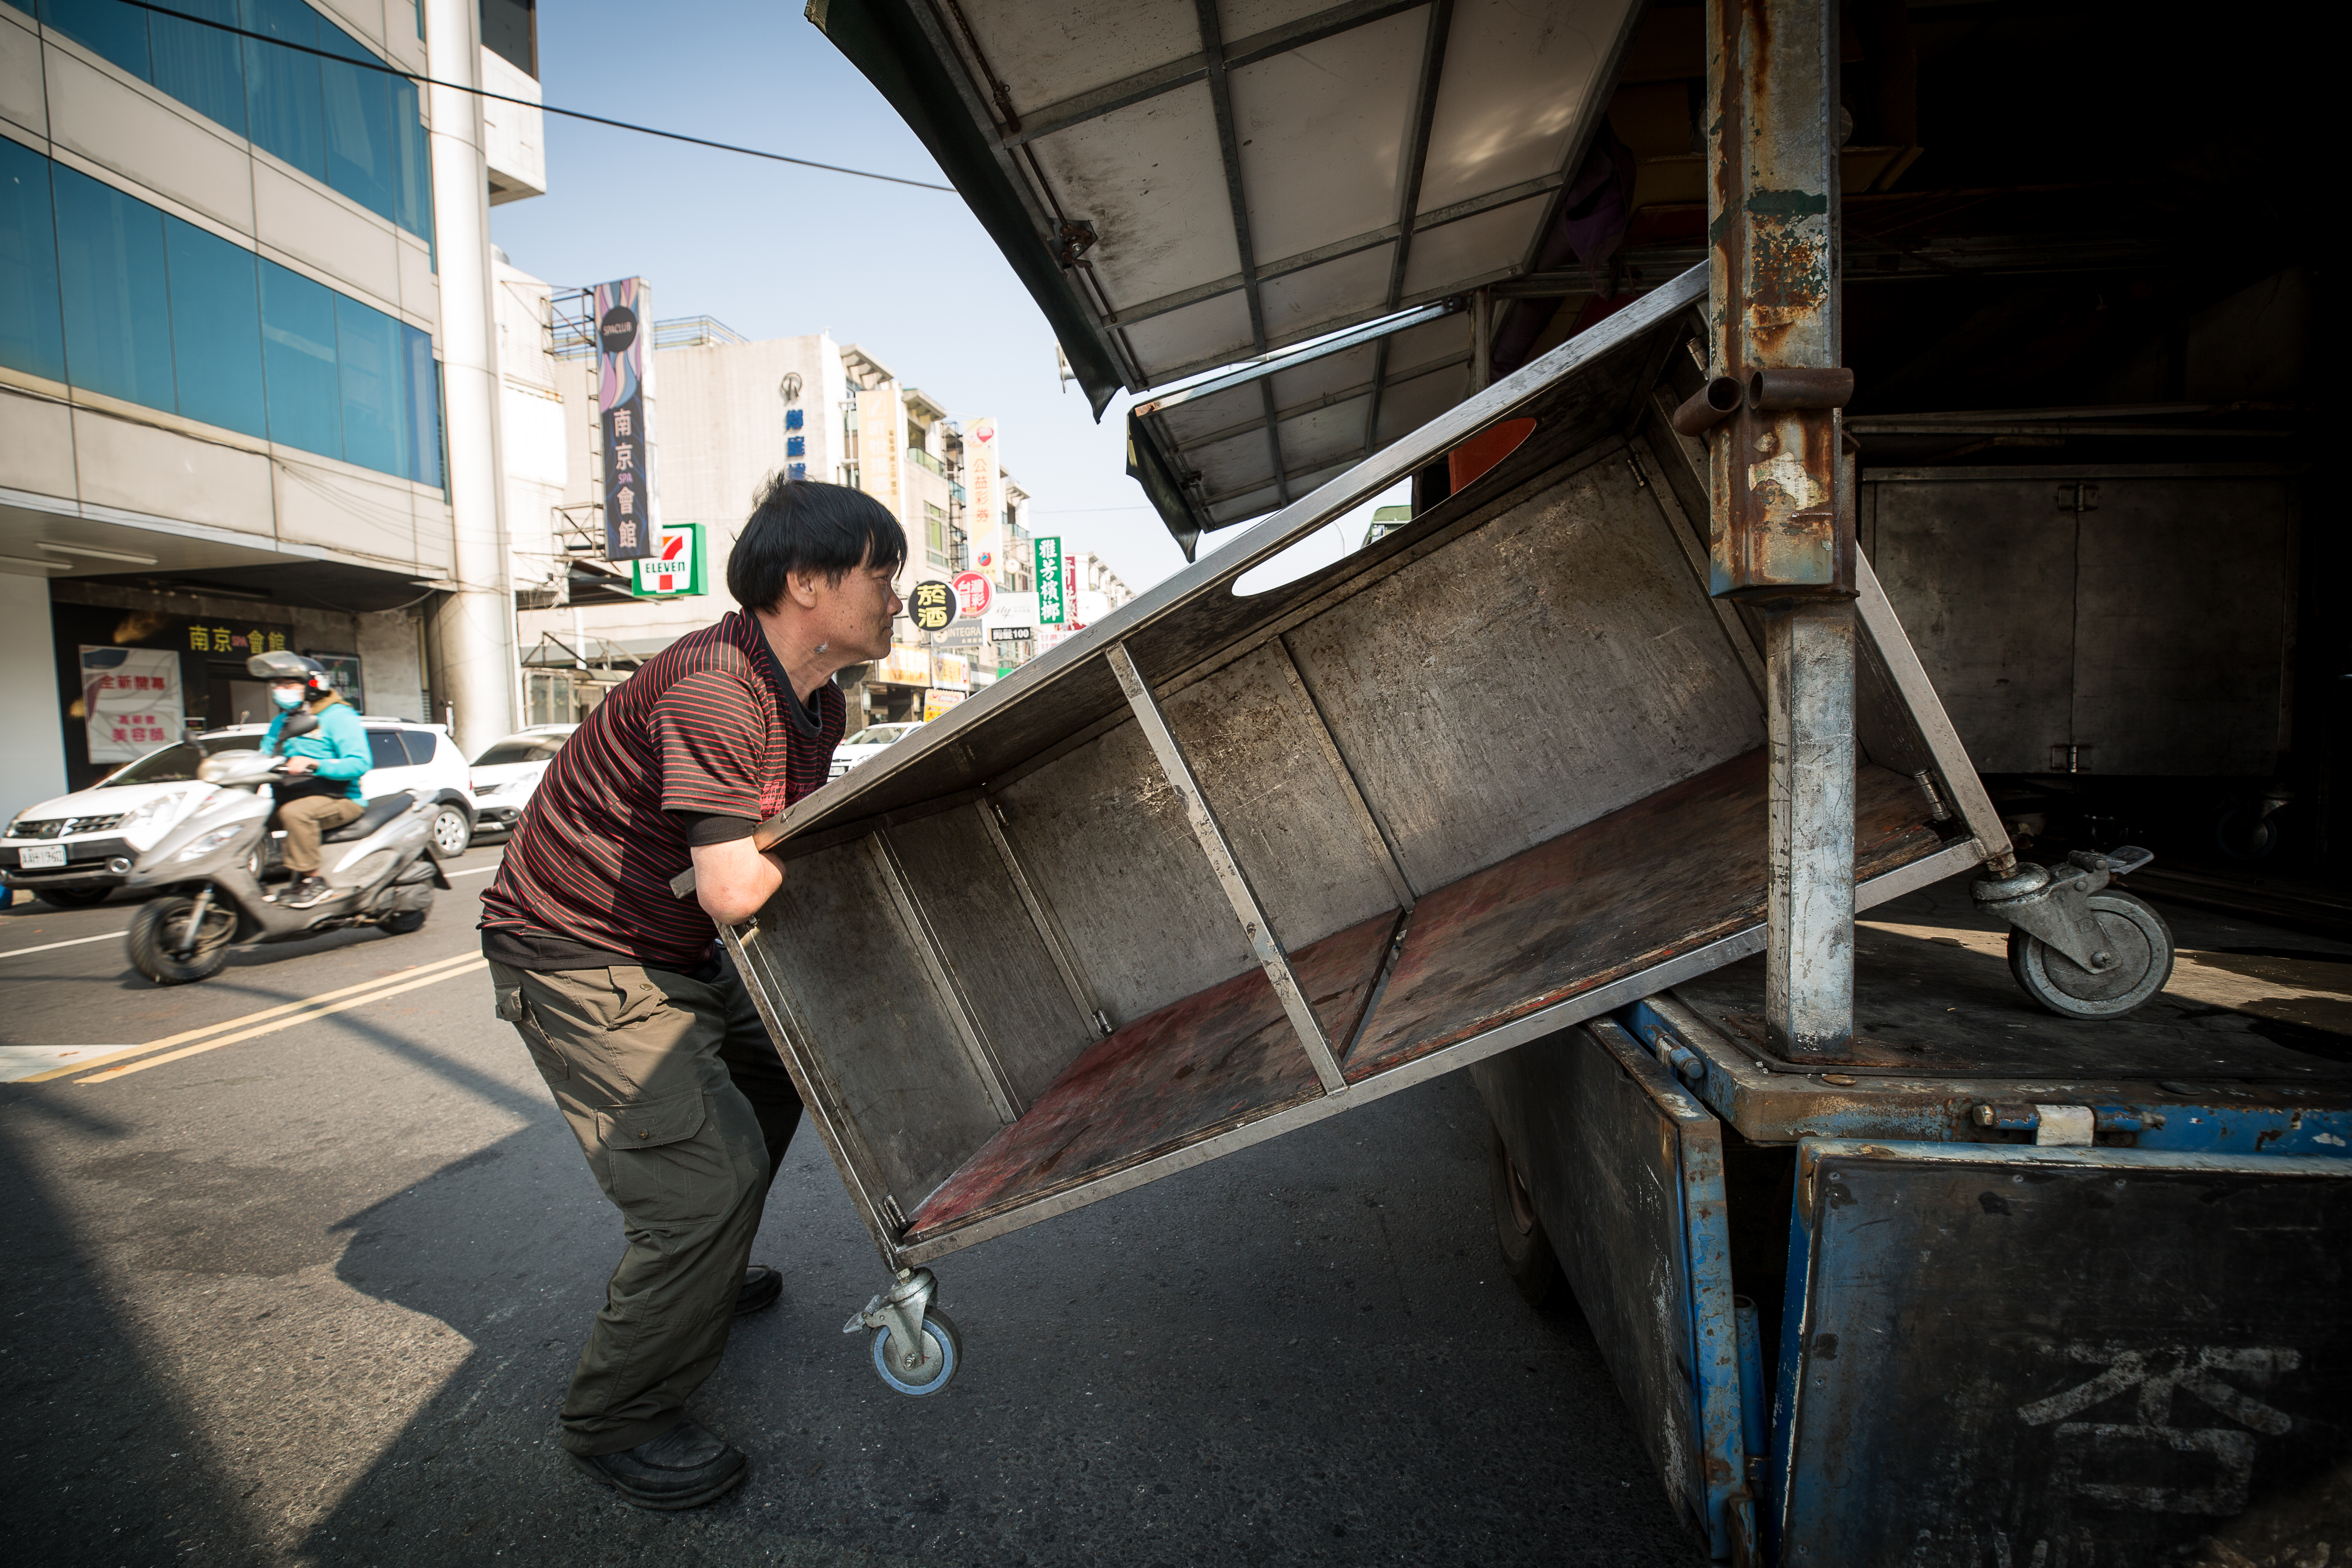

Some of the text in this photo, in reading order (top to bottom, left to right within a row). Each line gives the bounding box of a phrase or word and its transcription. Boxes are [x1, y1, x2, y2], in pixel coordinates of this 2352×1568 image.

[974, 458, 989, 522] 公益彩券
[917, 584, 947, 628] 菸酒
[1039, 539, 1060, 621] 雅芳檳榔
[948, 626, 982, 637] INTEGRA
